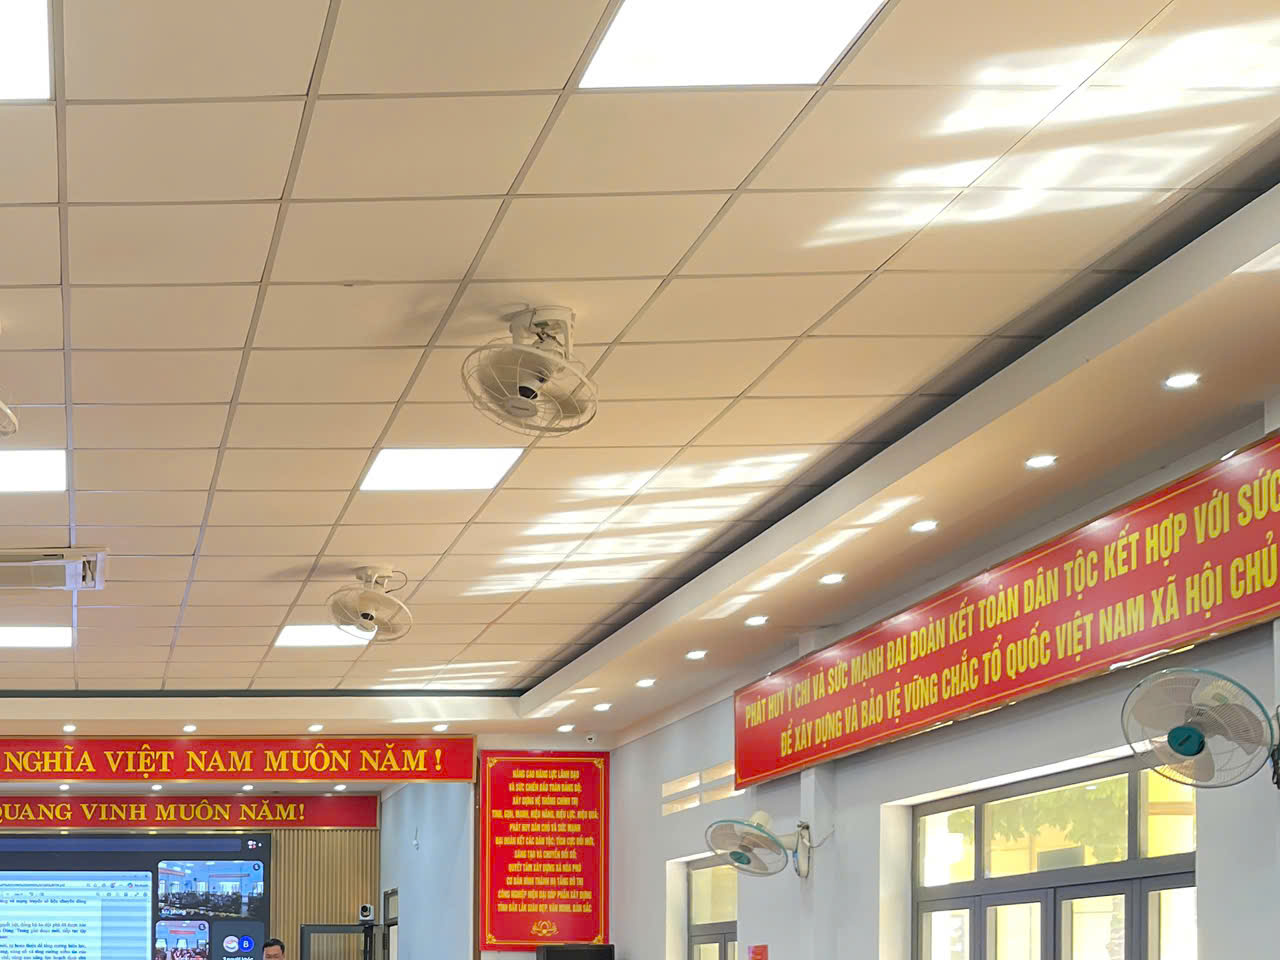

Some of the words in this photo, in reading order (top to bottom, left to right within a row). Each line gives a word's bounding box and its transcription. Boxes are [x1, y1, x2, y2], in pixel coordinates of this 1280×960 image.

[745, 699, 767, 728] PHÁT
[768, 692, 784, 720] HUY
[786, 684, 793, 713] Ý
[795, 680, 811, 708] CHÍ
[812, 671, 826, 700] VÀ
[827, 661, 848, 696] SỨC
[850, 648, 885, 686] MẠNH
[886, 635, 908, 672] ĐẠI
[909, 616, 946, 661] ĐOÀN
[948, 600, 976, 646] KẾT
[977, 584, 1020, 632] TOÀN
[1024, 568, 1059, 614] DÂN
[1064, 550, 1099, 600] TỘC
[1104, 523, 1141, 581] KẾT
[1145, 503, 1187, 566] HỢP
[1193, 489, 1230, 544] VỚI
[1237, 469, 1280, 527] SỨC
[780, 720, 794, 757] ĐỂ
[794, 720, 813, 752] XÂY
[814, 712, 843, 748] DỰNG
[844, 701, 860, 736] VÀ
[860, 688, 884, 730] BẢO
[886, 682, 902, 724] VỆ
[903, 672, 939, 712] VỮNG
[941, 648, 980, 700] CHẮC
[981, 632, 1003, 685] TỔ
[1005, 621, 1051, 680] QUỐC
[1056, 612, 1093, 662] VIỆT
[1099, 594, 1144, 644] NAM
[1152, 576, 1179, 626] XÃ
[1185, 560, 1223, 618] HỘI
[1229, 531, 1278, 599] CHỦ
[4, 744, 94, 772] NGHĨA
[106, 744, 174, 778] VIỆT
[188, 750, 253, 772] NAM
[264, 744, 348, 772] MUÔN
[360, 744, 427, 772] NĂM
[80, 804, 146, 821] VINH
[156, 800, 230, 821] MUÔN
[240, 800, 304, 821] NĂM!
